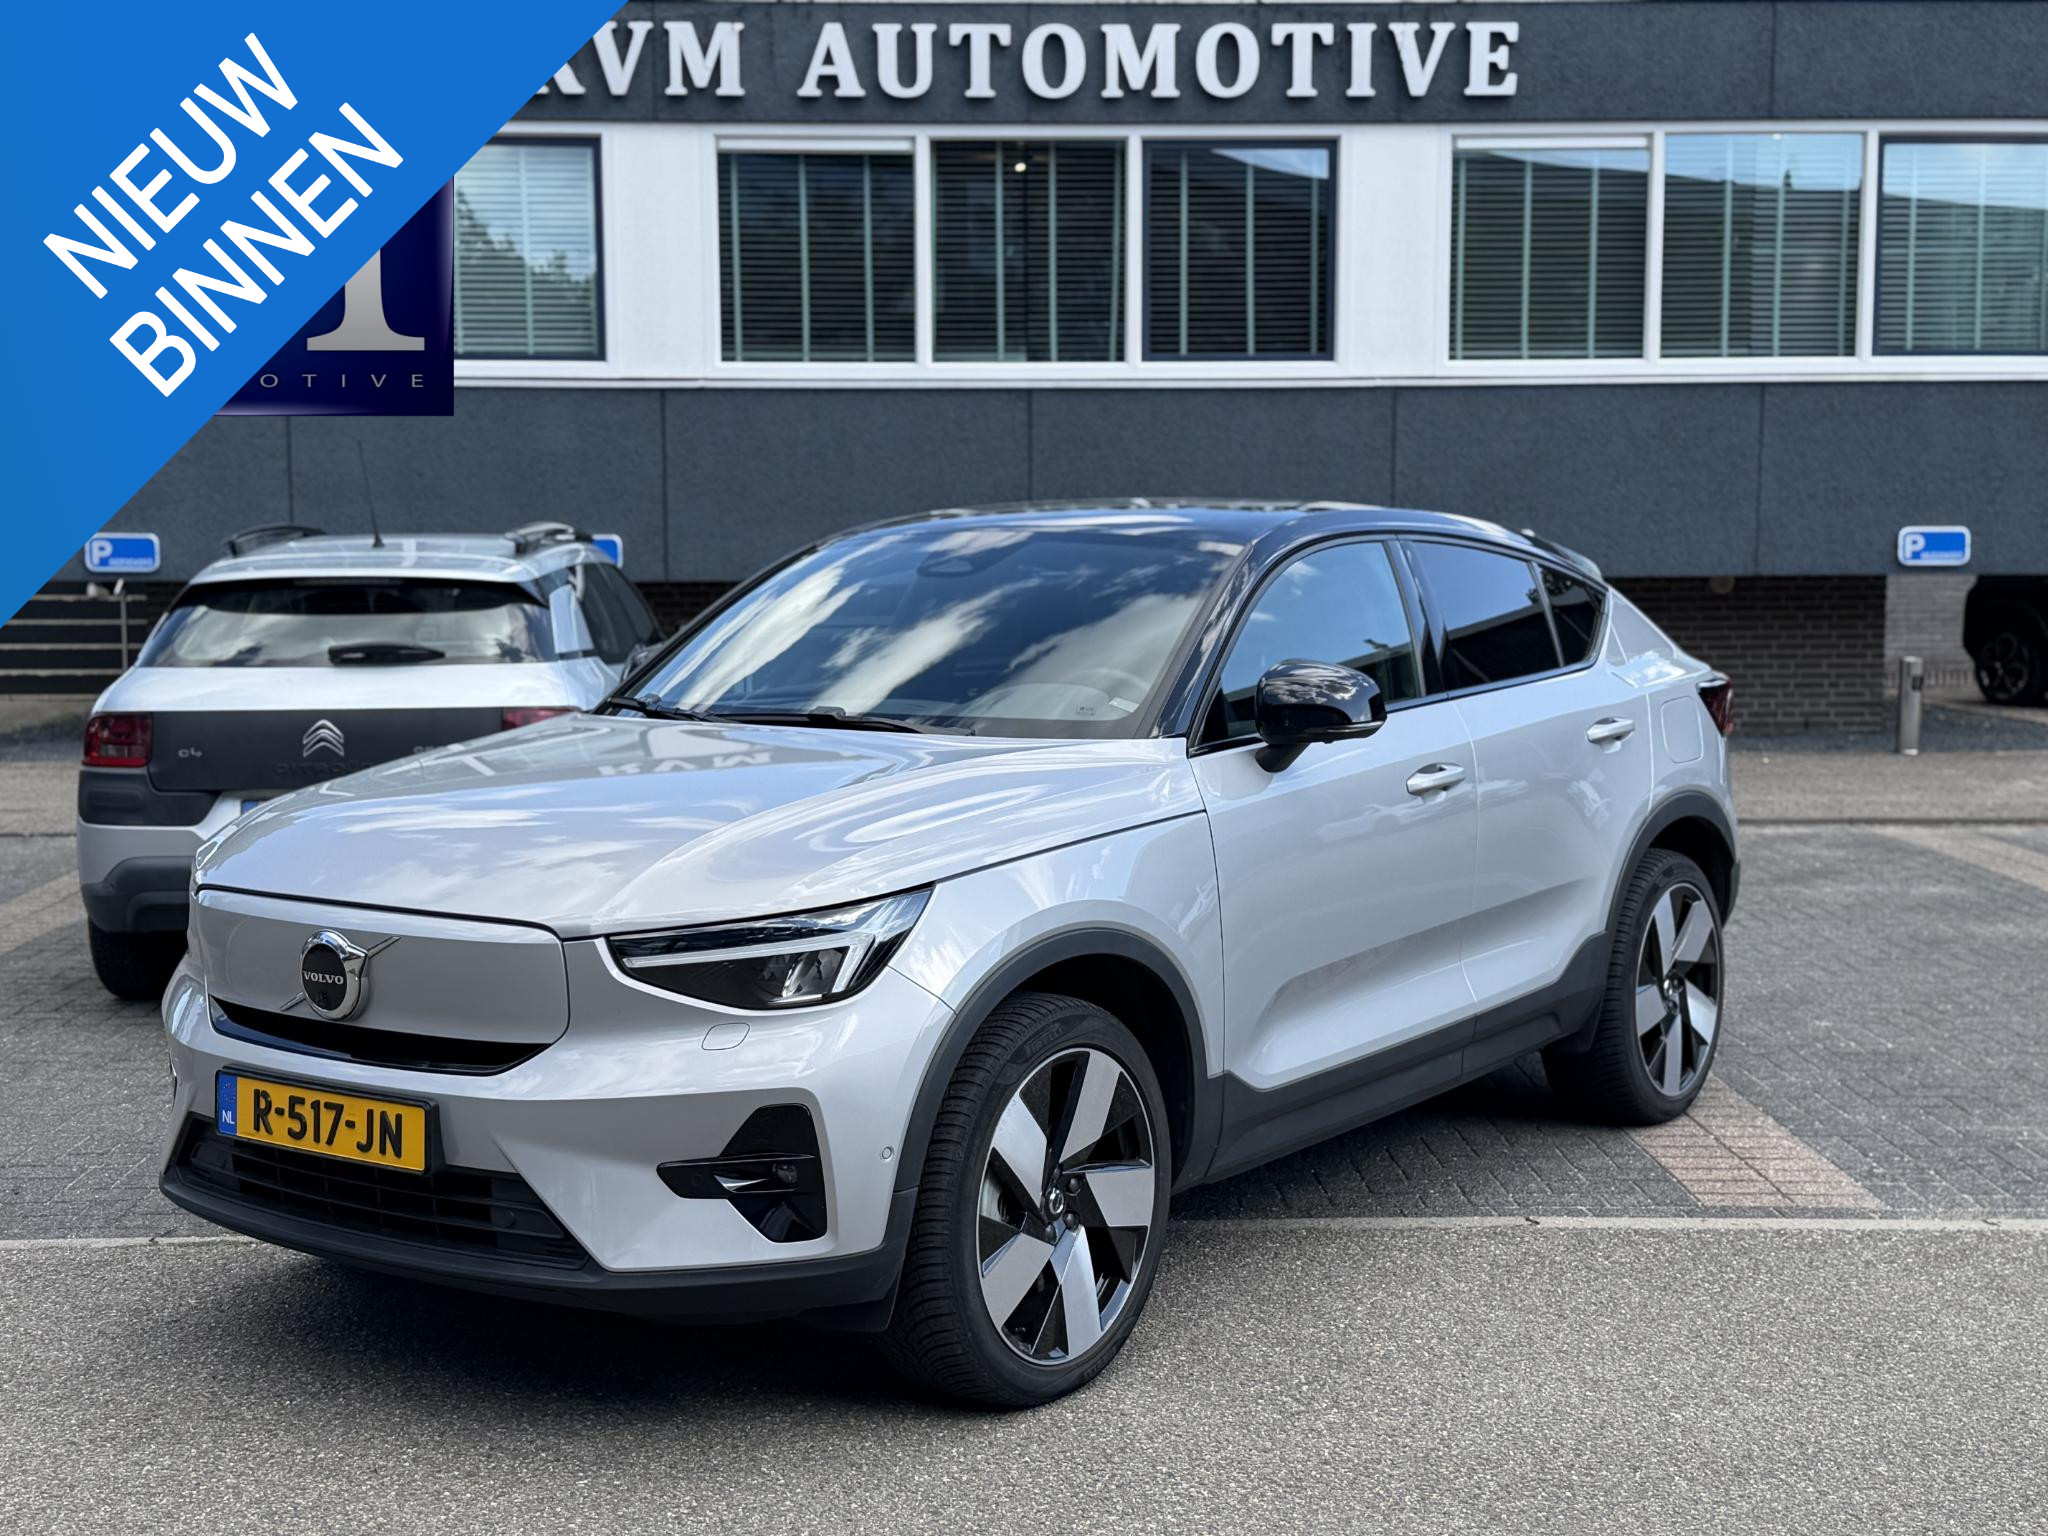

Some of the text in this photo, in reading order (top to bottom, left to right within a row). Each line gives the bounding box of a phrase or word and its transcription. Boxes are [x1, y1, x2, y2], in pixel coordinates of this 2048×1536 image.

[797, 21, 1520, 99] AUTOMOTIVE
[303, 970, 344, 985] VOLVO
[222, 1088, 403, 1159] NL R-517-JN
